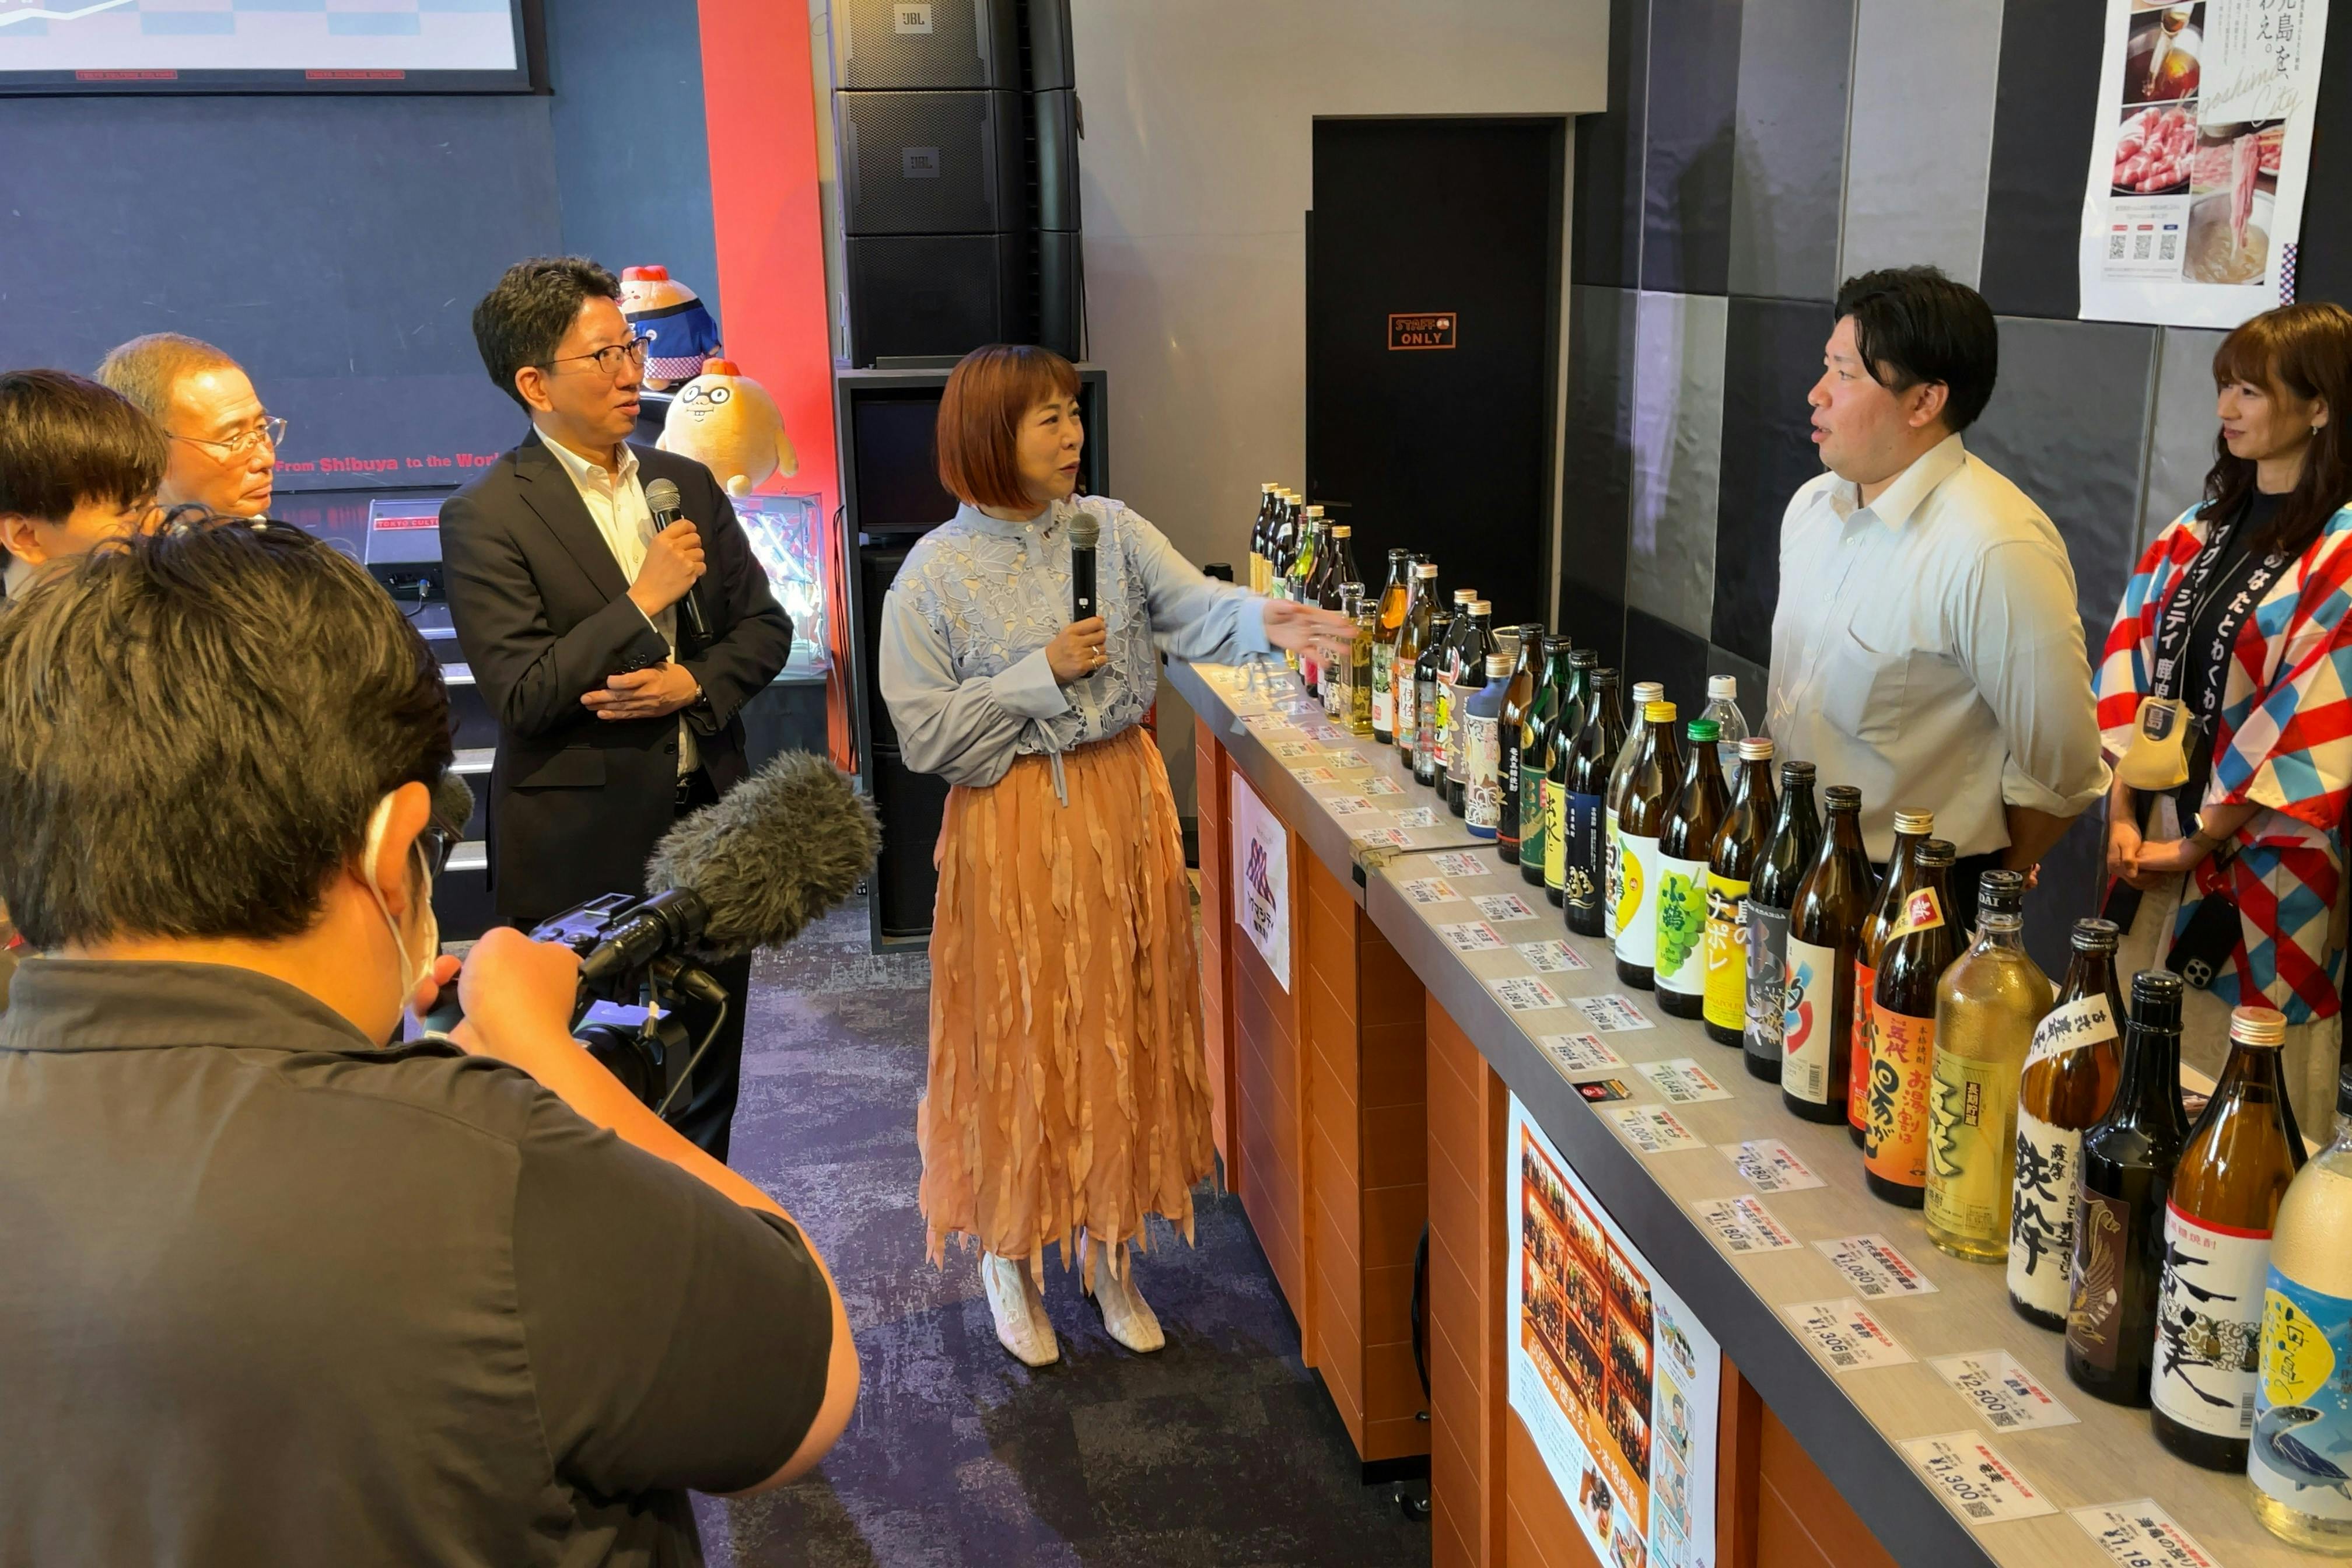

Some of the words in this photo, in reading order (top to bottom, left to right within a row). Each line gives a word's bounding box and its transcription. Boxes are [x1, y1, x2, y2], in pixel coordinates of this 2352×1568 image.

[902, 12, 925, 25] JBL
[2250, 83, 2305, 131] City
[910, 156, 933, 169] JBL
[1395, 318, 1436, 331] STAFF
[1401, 332, 1443, 344] ONLY
[275, 460, 315, 472] From
[406, 457, 423, 468] to
[426, 454, 452, 467] the
[1403, 687, 1414, 717] 伊佐
[1662, 876, 1688, 932] 小鶴
[1706, 892, 1730, 972] ナポレ
[1665, 947, 1676, 956] the
[1885, 1024, 1910, 1063] 五代
[1916, 1024, 1928, 1066] 本格焼酎
[1965, 1083, 1980, 1126] 長期貯蔵
[2049, 1143, 2068, 1186] 薩摩
[2013, 1130, 2059, 1277] 鉄幹
[1707, 1212, 1745, 1240] ¥1,180
[1834, 1253, 1877, 1283] ¥1,080
[1804, 1318, 1851, 1352] ¥1,306
[1955, 1374, 2008, 1412] ¥2,500
[1925, 1457, 1982, 1501] ¥1,300
[1975, 1462, 2007, 1483] 奄美
